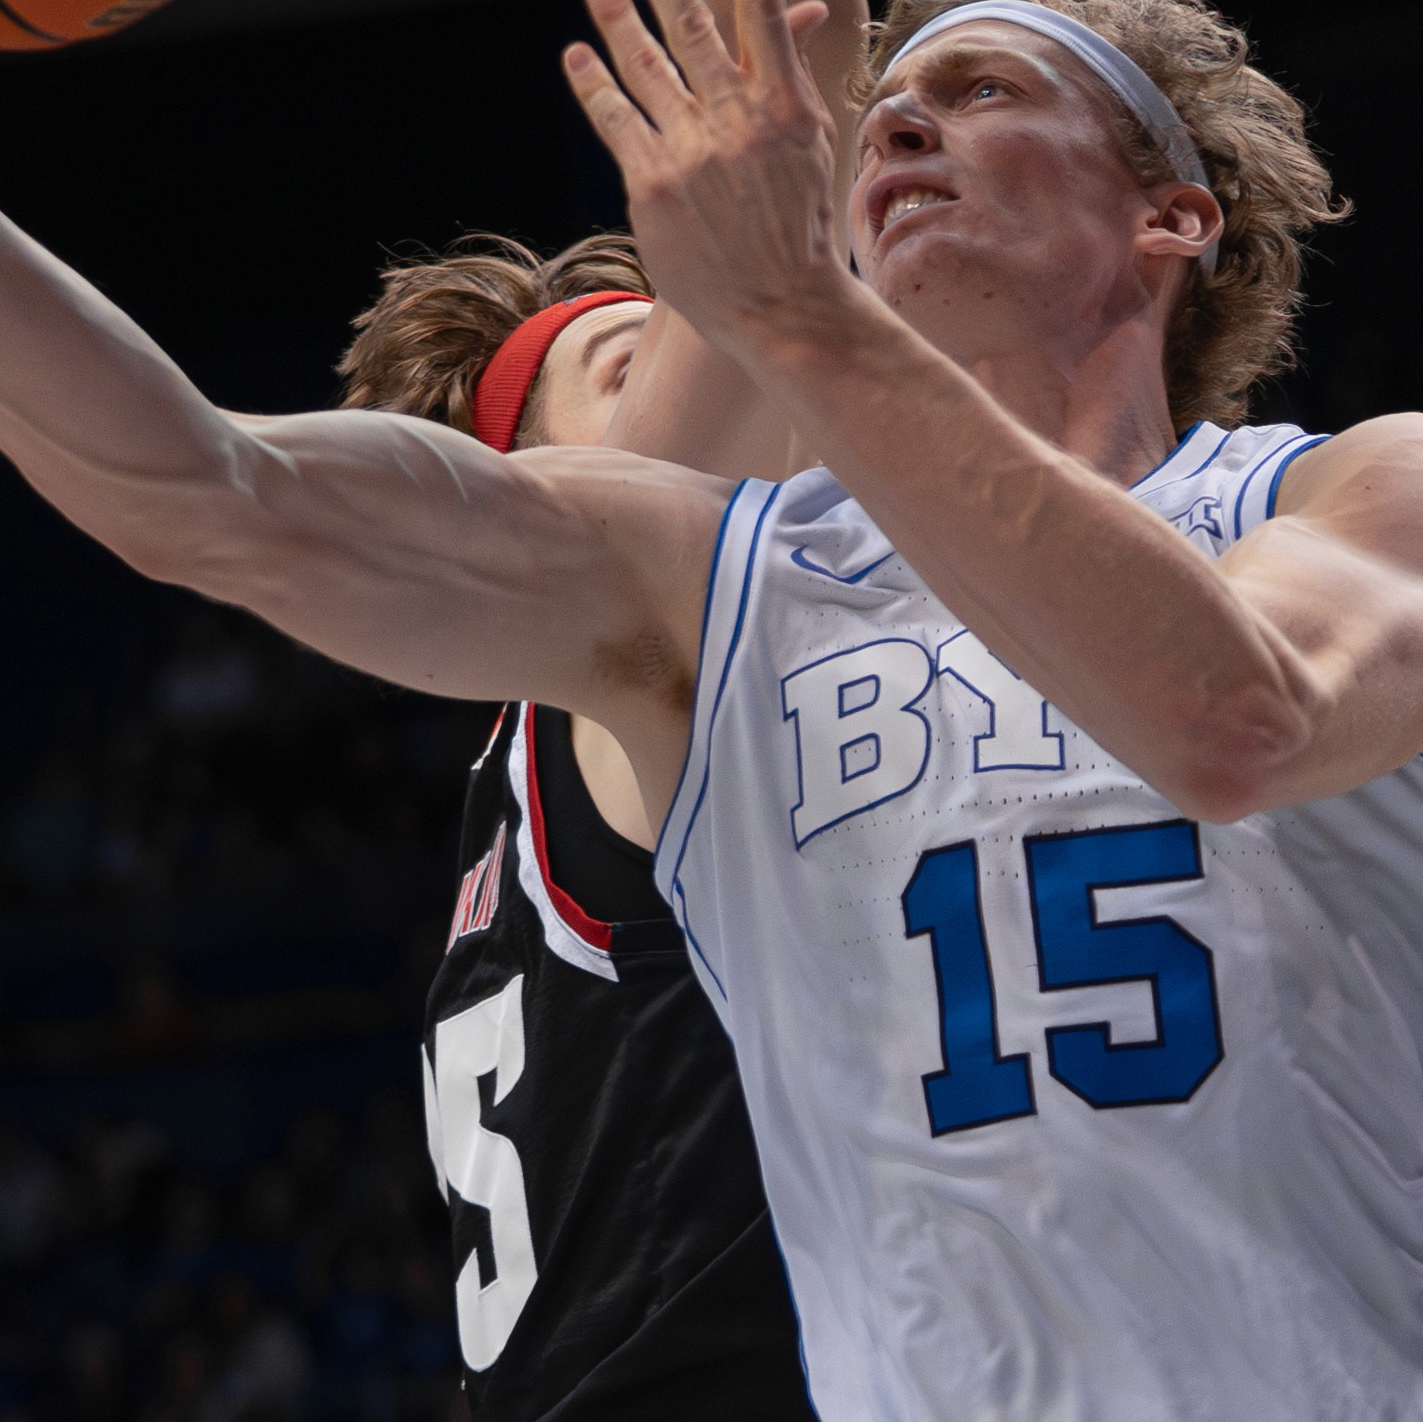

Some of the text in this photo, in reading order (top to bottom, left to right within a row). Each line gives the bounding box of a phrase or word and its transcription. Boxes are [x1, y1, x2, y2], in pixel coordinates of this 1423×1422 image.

[780, 628, 1066, 851] BY
[901, 819, 1225, 1138] 15
[422, 974, 538, 1372] 5
